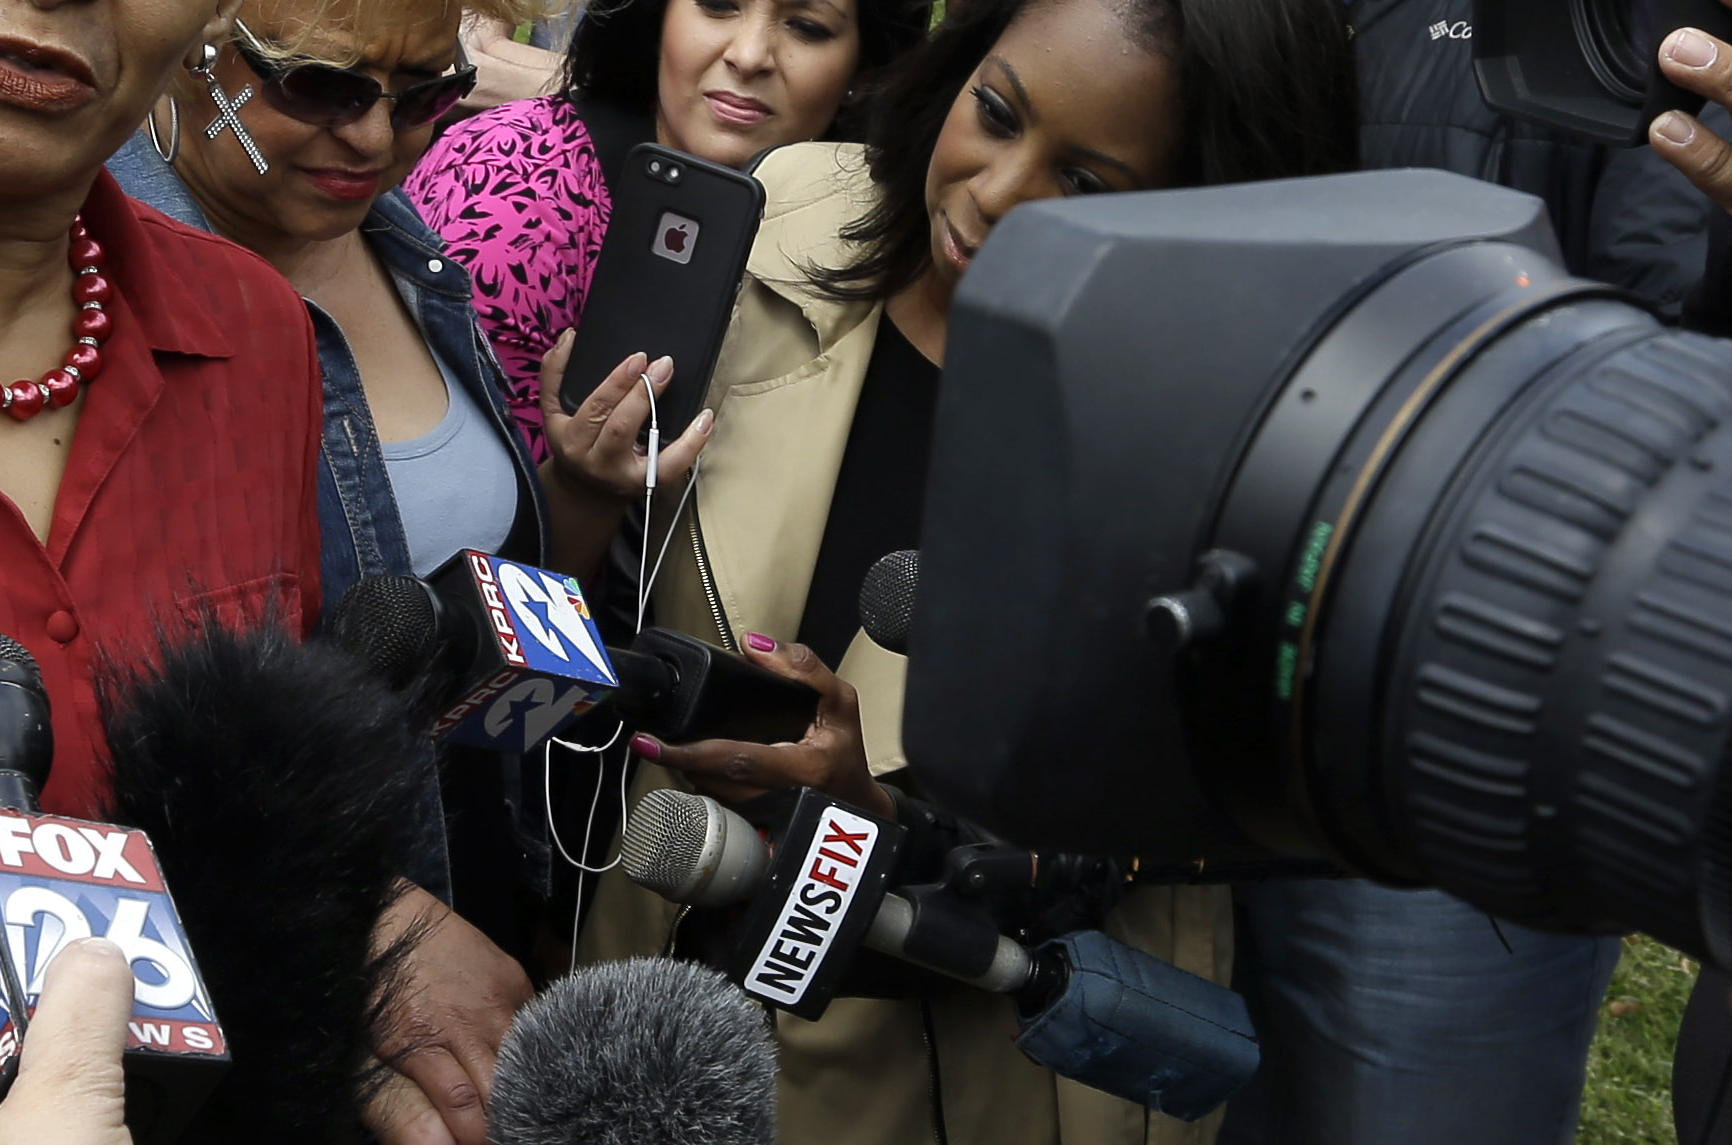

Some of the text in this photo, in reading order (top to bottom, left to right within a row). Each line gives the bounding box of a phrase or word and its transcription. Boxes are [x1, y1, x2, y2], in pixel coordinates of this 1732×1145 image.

[471, 555, 526, 664] KPRC
[430, 670, 518, 737] KPRC
[5, 886, 196, 1010] 26
[755, 819, 870, 995] NEWSFIX
